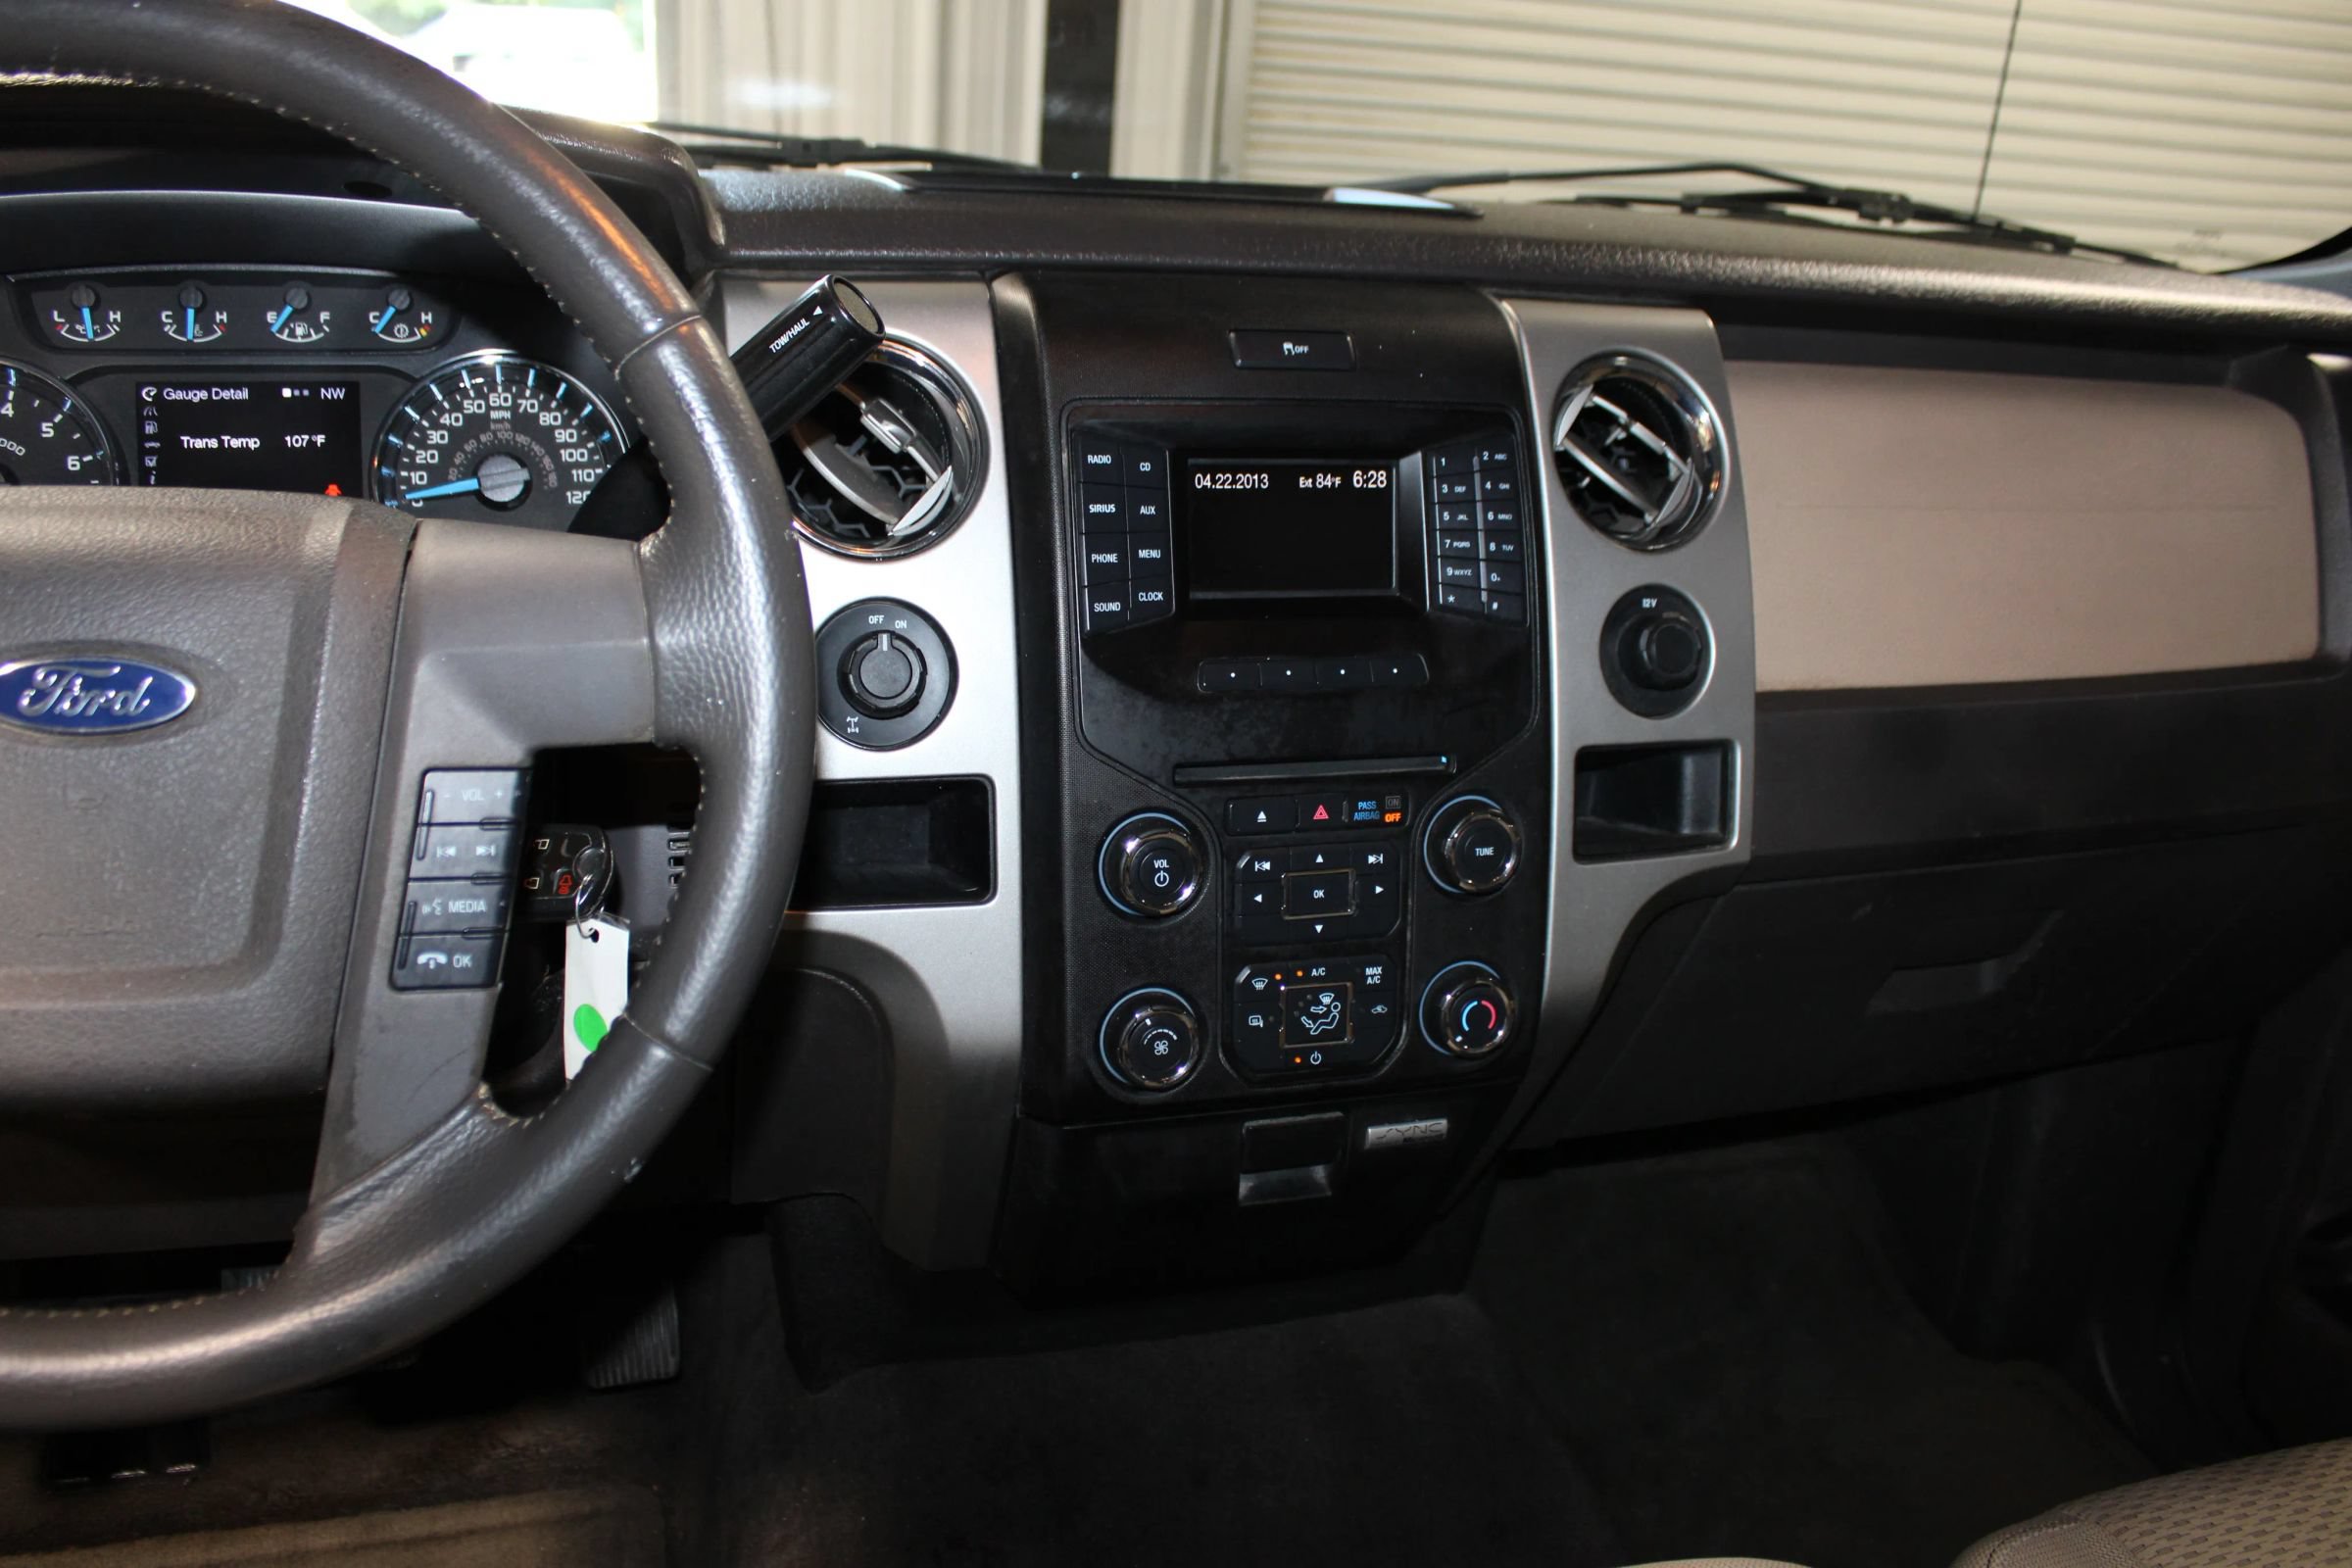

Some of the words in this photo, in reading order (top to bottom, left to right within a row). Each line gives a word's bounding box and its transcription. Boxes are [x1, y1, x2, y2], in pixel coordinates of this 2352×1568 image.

[53, 311, 65, 322] L
[110, 311, 121, 322] H
[162, 311, 173, 322] C
[216, 311, 227, 323] H
[267, 312, 277, 323] E
[320, 312, 330, 323] F
[369, 312, 380, 323] C
[421, 312, 432, 323] H
[769, 318, 809, 353] TOW/HAUL
[1295, 345, 1309, 354] OFF
[163, 388, 208, 402] Gauge
[212, 388, 248, 400] Detail
[321, 388, 345, 400] NW
[489, 394, 511, 407] 60
[0, 402, 14, 417] 4
[464, 400, 485, 413] 50
[517, 399, 538, 413] 70
[440, 413, 463, 426] 40
[490, 411, 511, 420] MPH
[539, 412, 561, 425] 80
[41, 422, 54, 438] 5
[490, 421, 511, 430] km/h
[427, 430, 448, 444] 30
[497, 431, 514, 440] 100
[555, 429, 577, 442] 90
[180, 436, 218, 448] Trans
[221, 436, 260, 450] Temp
[416, 450, 438, 463] 20
[560, 449, 588, 462] 100
[1087, 455, 1111, 465] RADIO
[1483, 451, 1489, 461] 2
[67, 456, 80, 471] 6
[1140, 463, 1151, 471] CD
[1441, 458, 1446, 466] 1
[410, 471, 427, 485] 10
[572, 469, 594, 482] 110
[1195, 473, 1269, 489] 04.22.2013
[1299, 477, 1312, 488] Ext
[1353, 470, 1387, 488] 6:28
[1442, 484, 1448, 493] 3
[1485, 481, 1491, 490] 4
[1089, 504, 1116, 513] SIRIUS
[1140, 506, 1156, 515] AUX
[1444, 512, 1449, 521] 5
[1488, 512, 1494, 521] 6
[1445, 539, 1451, 549] 7
[1490, 542, 1496, 552] 8
[1091, 554, 1118, 564] PHONE
[1139, 549, 1161, 559] MENU
[1446, 566, 1453, 576] 9
[1139, 592, 1163, 602] CLOCK
[1094, 602, 1121, 612] SOUND
[1642, 598, 1657, 608] 12V
[869, 615, 884, 625] OFF
[895, 620, 907, 629] ON
[18, 666, 153, 716] Ford
[462, 789, 485, 802] VOL
[1358, 801, 1377, 810] PASS
[1388, 797, 1399, 807] ON
[1354, 811, 1380, 821] AIRBAG
[1385, 812, 1401, 823] OFF
[1474, 847, 1494, 857] TUNE
[1153, 859, 1170, 868] VOL
[1313, 890, 1324, 898] OK
[448, 902, 486, 913] MEDIA
[453, 955, 472, 967] OK
[1311, 967, 1325, 977] A/C
[1366, 966, 1382, 976] MAX
[1367, 976, 1381, 985] A/C
